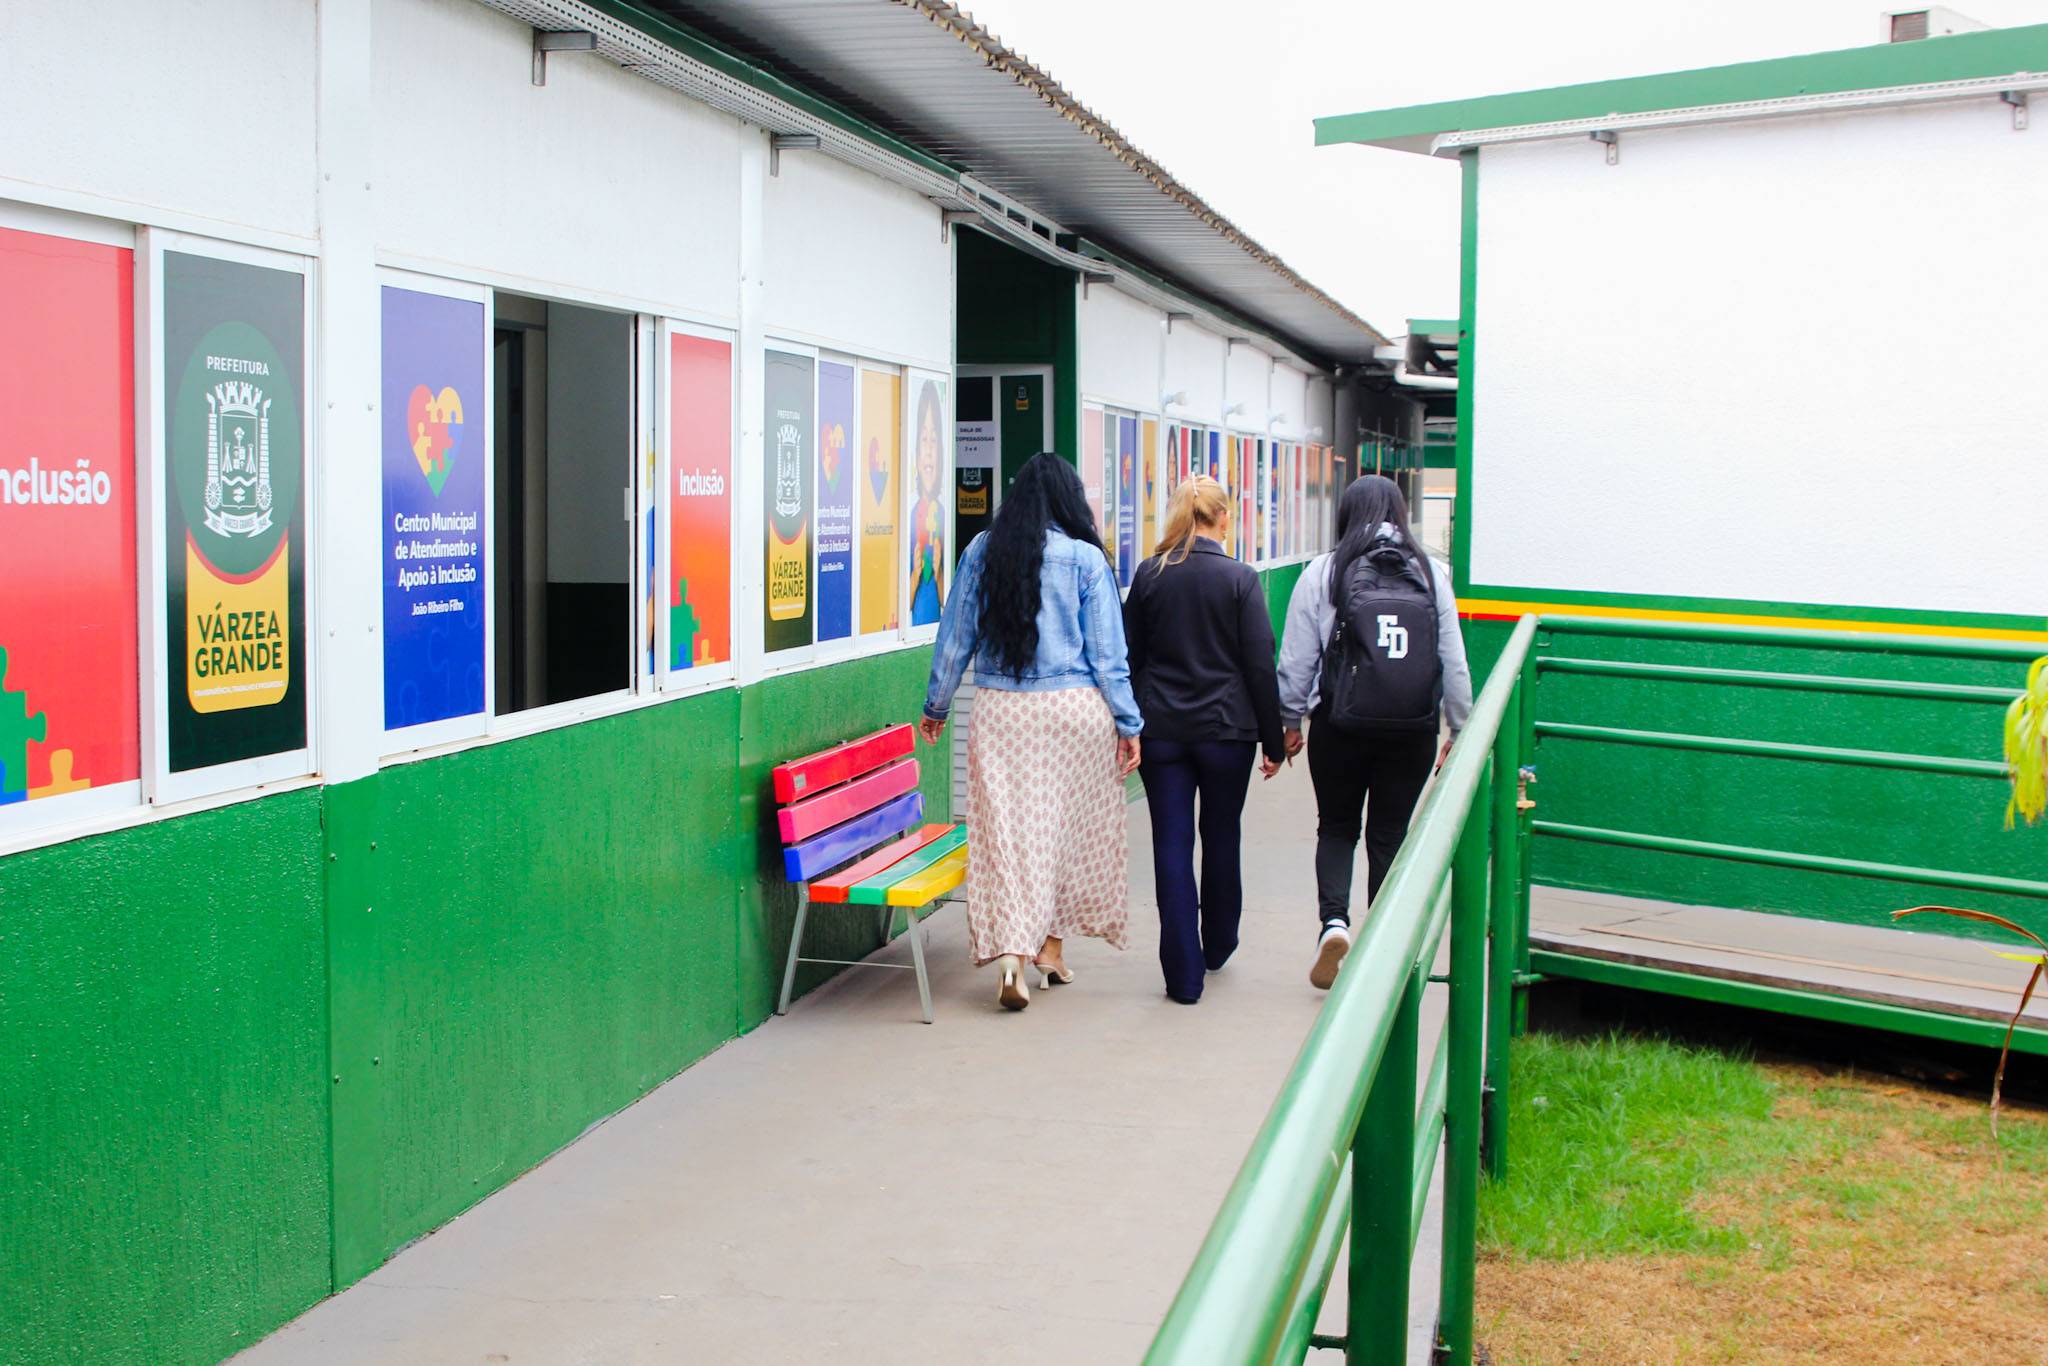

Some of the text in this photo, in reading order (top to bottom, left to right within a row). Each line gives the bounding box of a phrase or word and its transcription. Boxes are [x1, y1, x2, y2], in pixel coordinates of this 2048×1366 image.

[207, 355, 270, 376] PREFEITURA
[0, 457, 111, 505] nclusão
[680, 468, 724, 496] Inclusão
[395, 512, 477, 535] Centro Municipal
[396, 539, 477, 560] de Atendimento e
[399, 563, 476, 592] Apoio à Inclusão
[773, 555, 803, 579] VÁRZEA
[772, 580, 804, 599] GRANDE
[412, 599, 464, 616] João Ribeiro Filho
[197, 601, 281, 644] VÁRZEA
[195, 641, 283, 677] GRANDE
